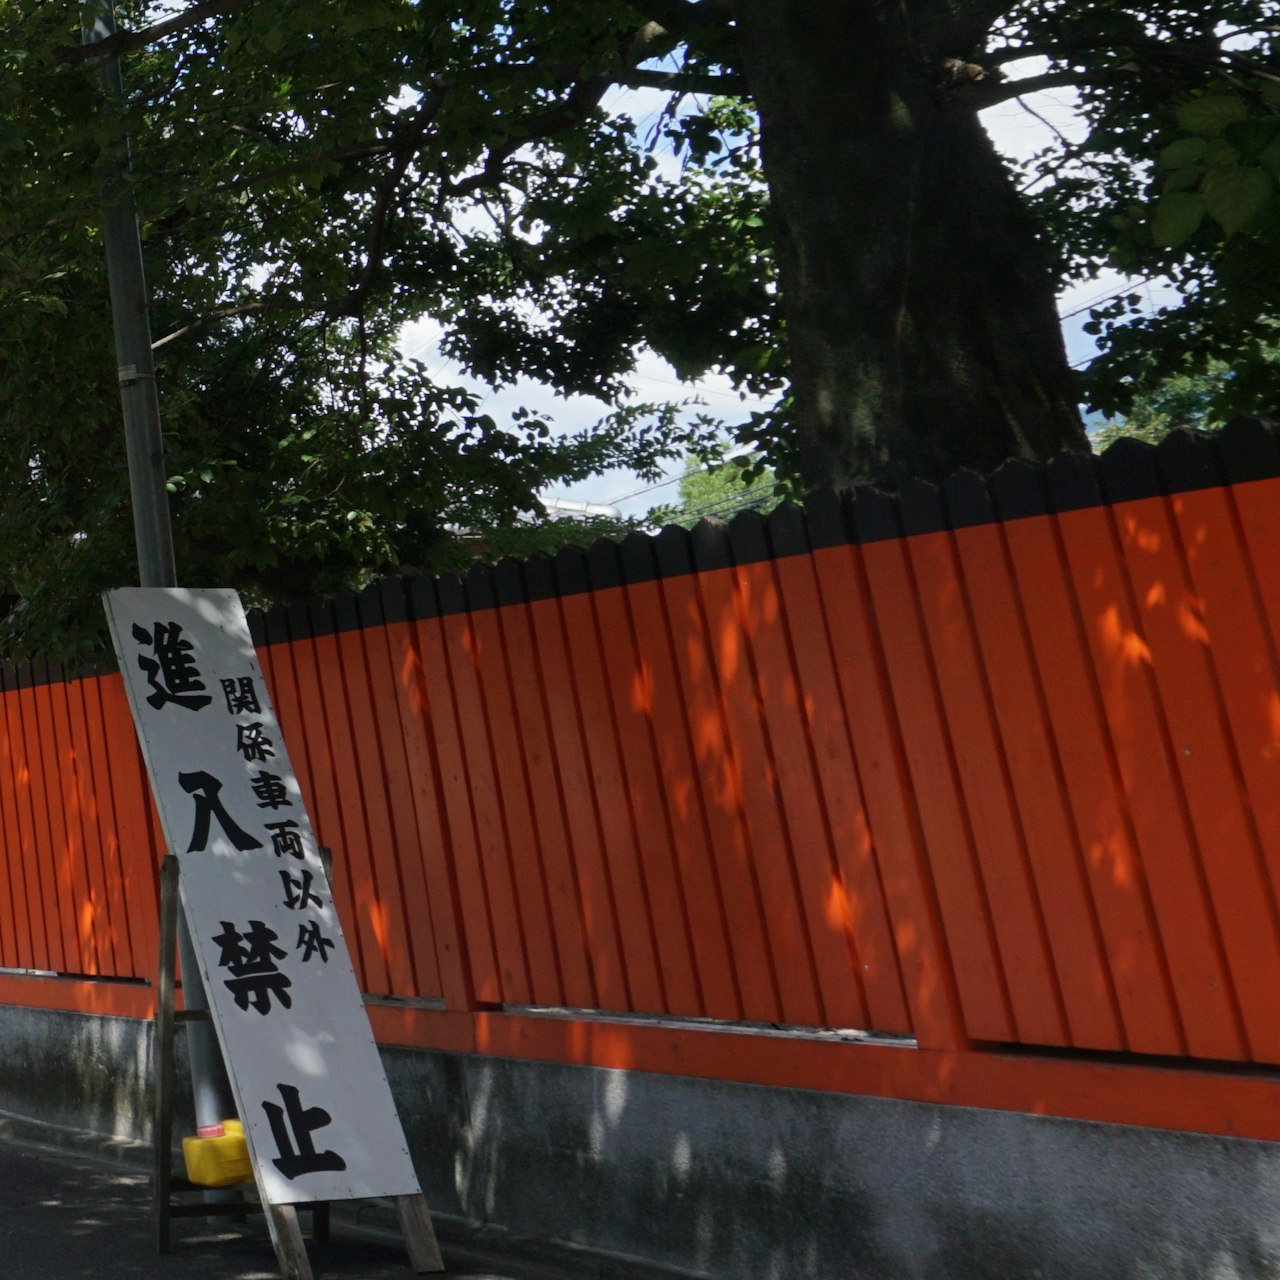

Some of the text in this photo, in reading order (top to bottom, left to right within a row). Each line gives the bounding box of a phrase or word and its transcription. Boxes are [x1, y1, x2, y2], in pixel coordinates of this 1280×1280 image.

[131, 621, 346, 1180] 進入禁止
[219, 676, 335, 964] 関係車両以外
